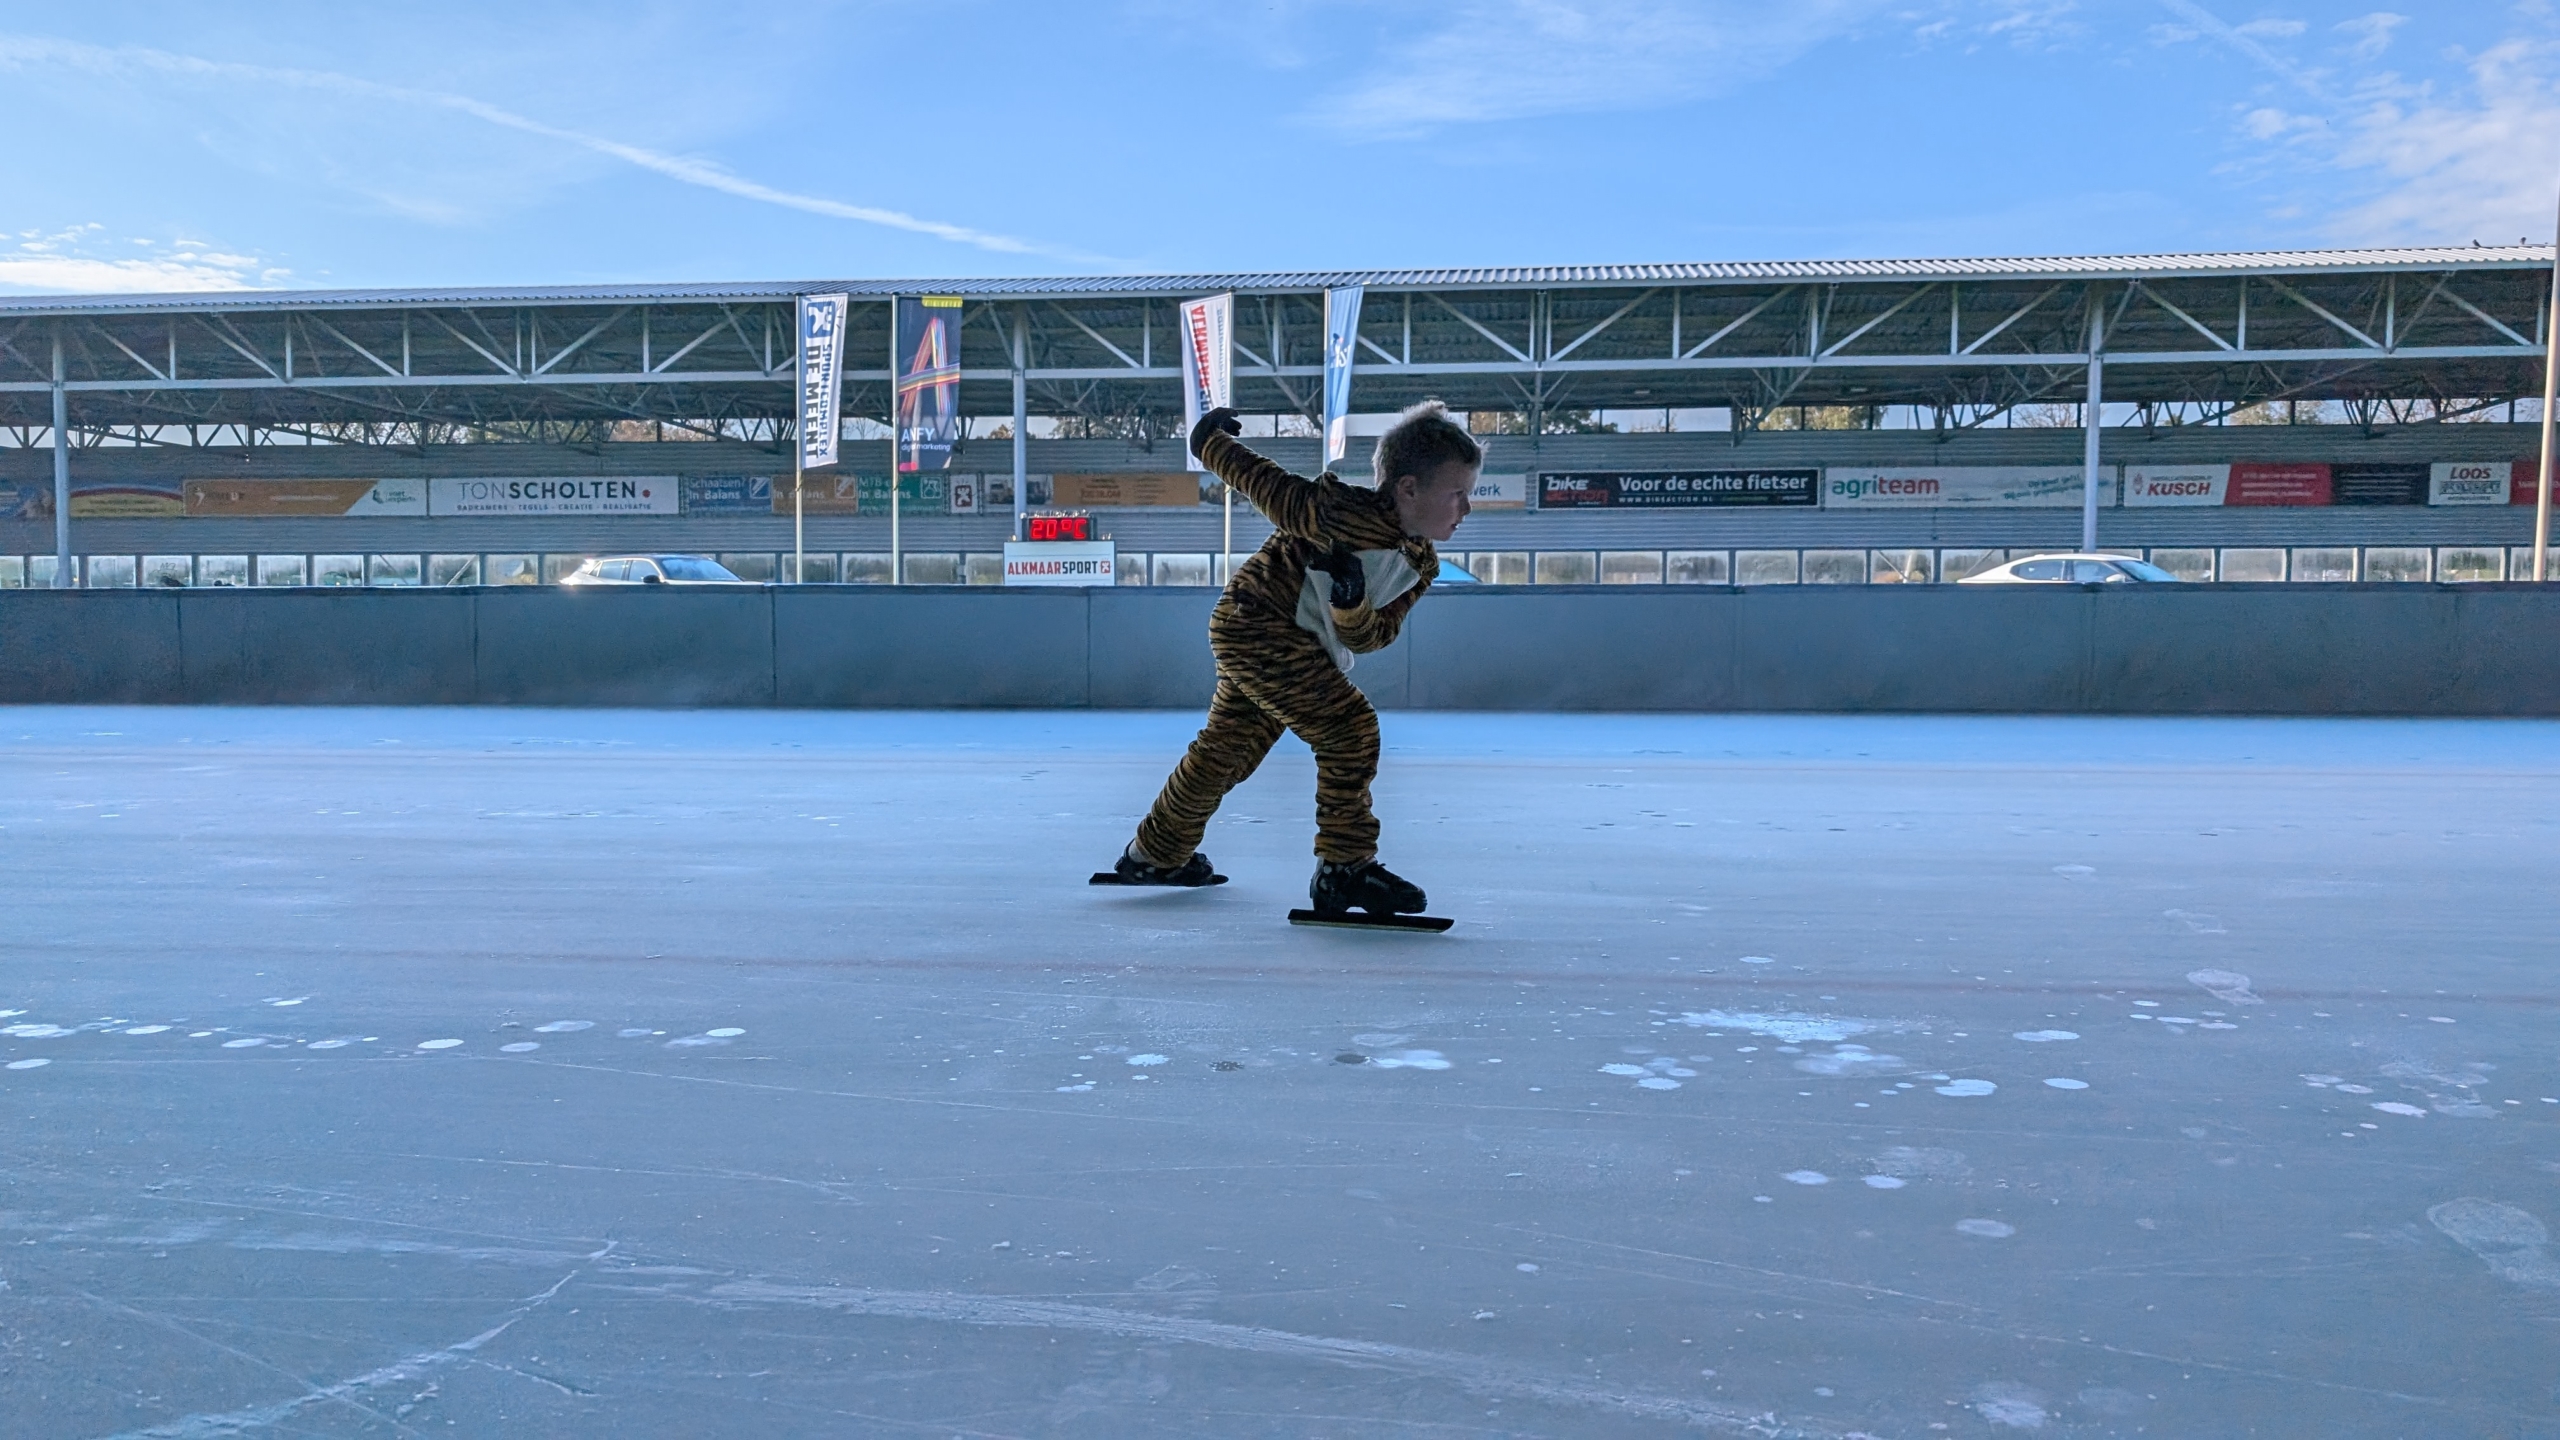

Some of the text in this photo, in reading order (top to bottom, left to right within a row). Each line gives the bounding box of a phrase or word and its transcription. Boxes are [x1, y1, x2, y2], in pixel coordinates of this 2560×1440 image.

[805, 345, 821, 458] DE MEENT
[818, 343, 832, 456] SPORTCOMPLEX
[901, 427, 936, 443] ANFY
[1618, 474, 1809, 491] Voor de echte fietser
[1832, 474, 1940, 499] agriteam
[2147, 482, 2211, 496] KUSCH
[690, 489, 741, 500] In Balans
[858, 490, 868, 499] In
[1030, 518, 1087, 540] 20°C
[1007, 561, 1098, 575] ALKMAARSPORT
